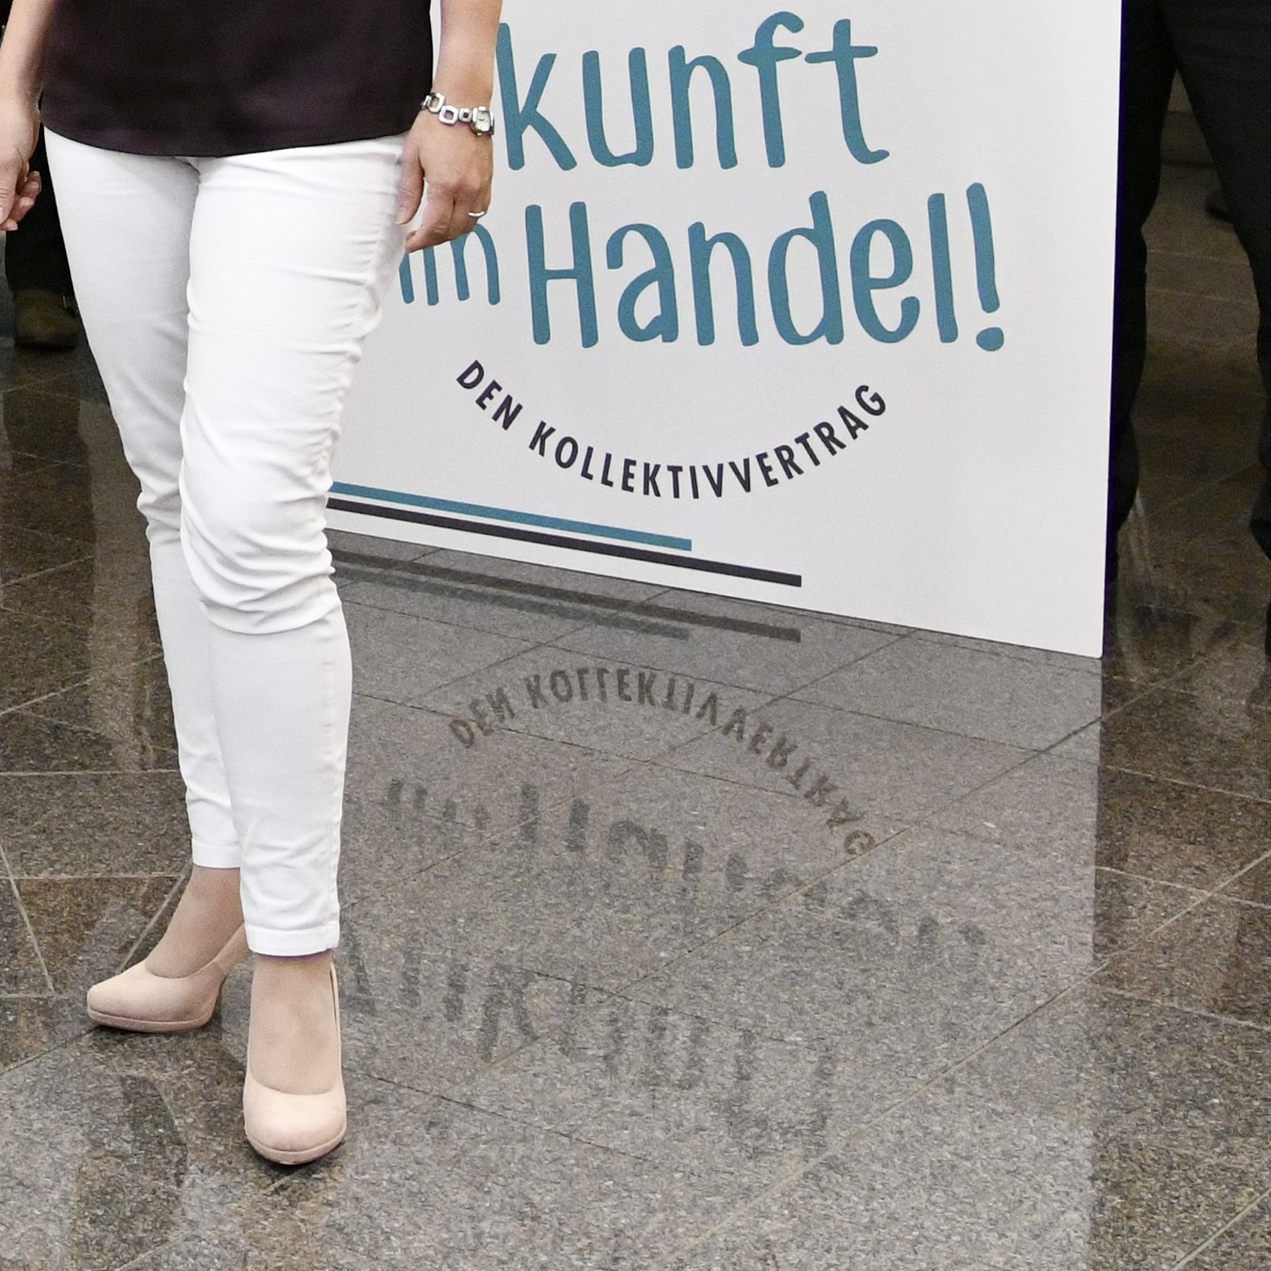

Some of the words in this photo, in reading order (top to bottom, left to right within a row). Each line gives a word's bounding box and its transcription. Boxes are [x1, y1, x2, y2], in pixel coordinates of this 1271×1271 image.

[495, 11, 890, 172] kunft
[525, 183, 1004, 353] Handel!
[457, 360, 523, 430] DEN
[529, 385, 886, 499] KOLLEKTIVVERTRAG
